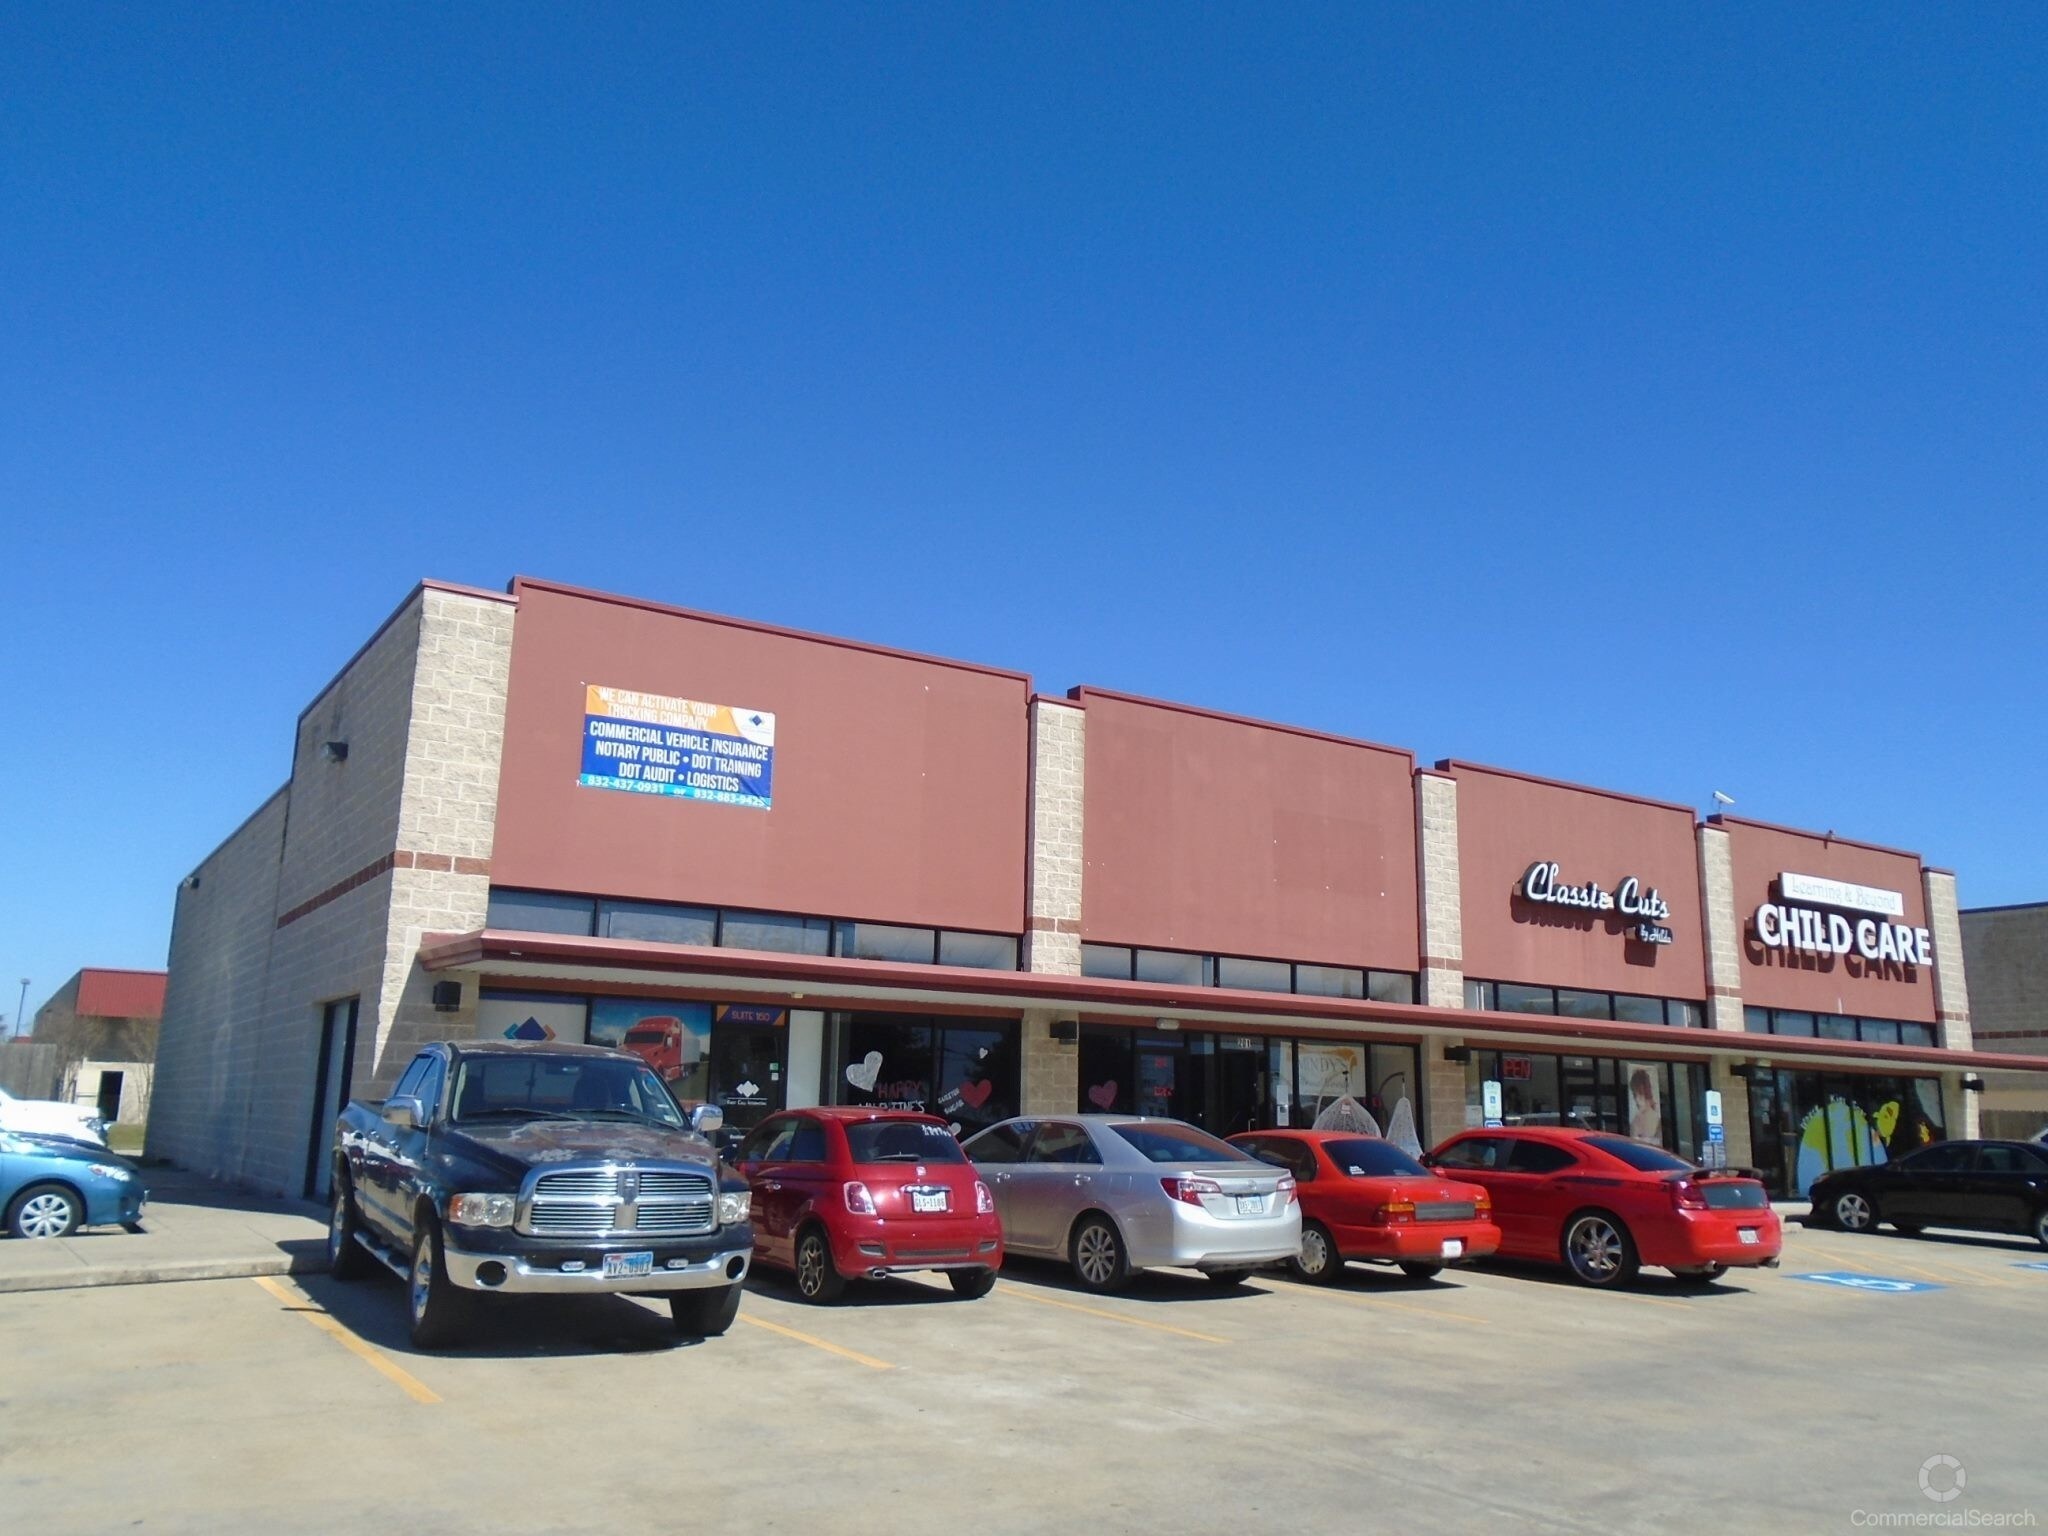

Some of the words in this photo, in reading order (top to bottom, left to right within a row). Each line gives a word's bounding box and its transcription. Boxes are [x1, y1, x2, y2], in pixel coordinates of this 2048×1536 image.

[599, 687, 616, 701] WE
[618, 690, 642, 705] CAN
[642, 692, 688, 714] ACTIVATE
[691, 702, 717, 718] YOUR
[607, 703, 659, 724] TRUCKING
[660, 711, 709, 731] COMPANY
[590, 720, 664, 746] COMMERCIAL
[666, 731, 709, 751] VEHICLE
[711, 738, 769, 761] INSURANCE
[595, 740, 641, 761] NOTARY
[642, 746, 680, 766] PUBLIC
[691, 754, 713, 771] DOT
[715, 757, 762, 778] TRAINING
[618, 761, 642, 779] DOT
[643, 766, 676, 784] AUDIT
[686, 771, 739, 792] LOGISTICS
[1527, 863, 1609, 909] Classic
[1619, 877, 1670, 919] Cuts
[1757, 903, 1851, 954] CHILD
[1857, 918, 1933, 966] CARE
[731, 1010, 754, 1021] SUITE
[877, 1080, 922, 1099] HAPPY
